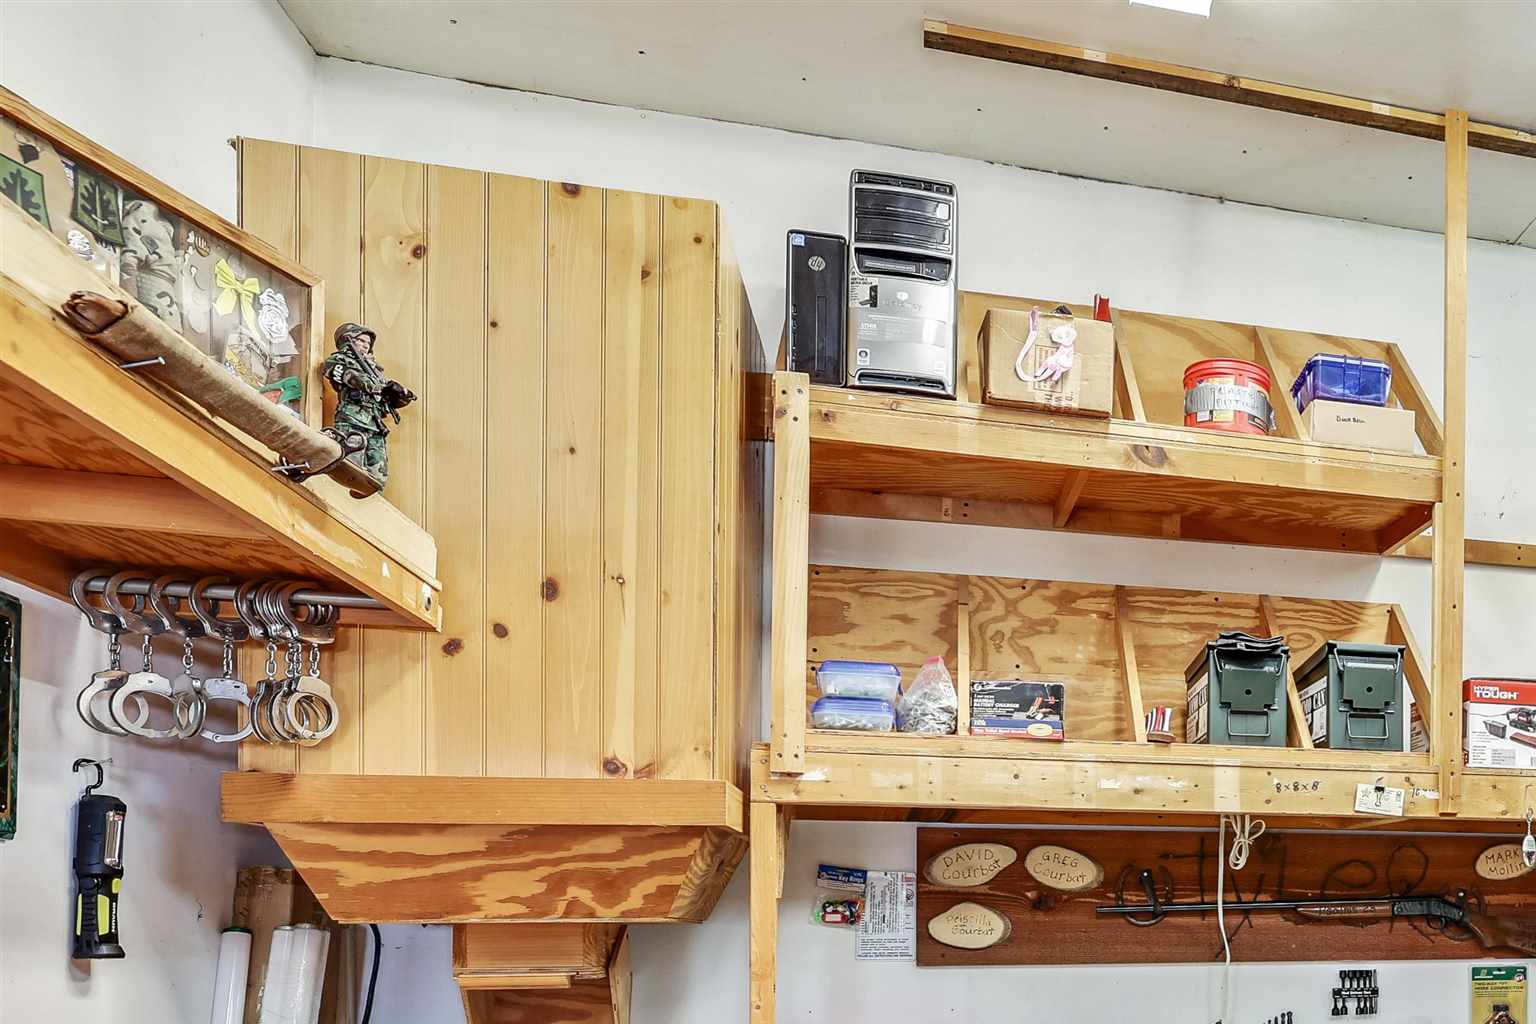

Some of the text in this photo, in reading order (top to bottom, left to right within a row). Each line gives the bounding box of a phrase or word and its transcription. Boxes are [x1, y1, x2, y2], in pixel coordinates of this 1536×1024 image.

[1474, 690, 1518, 700] TOUGH
[943, 849, 994, 868] DAVID
[1042, 852, 1079, 868] GREG
[1485, 848, 1520, 865] MARK
